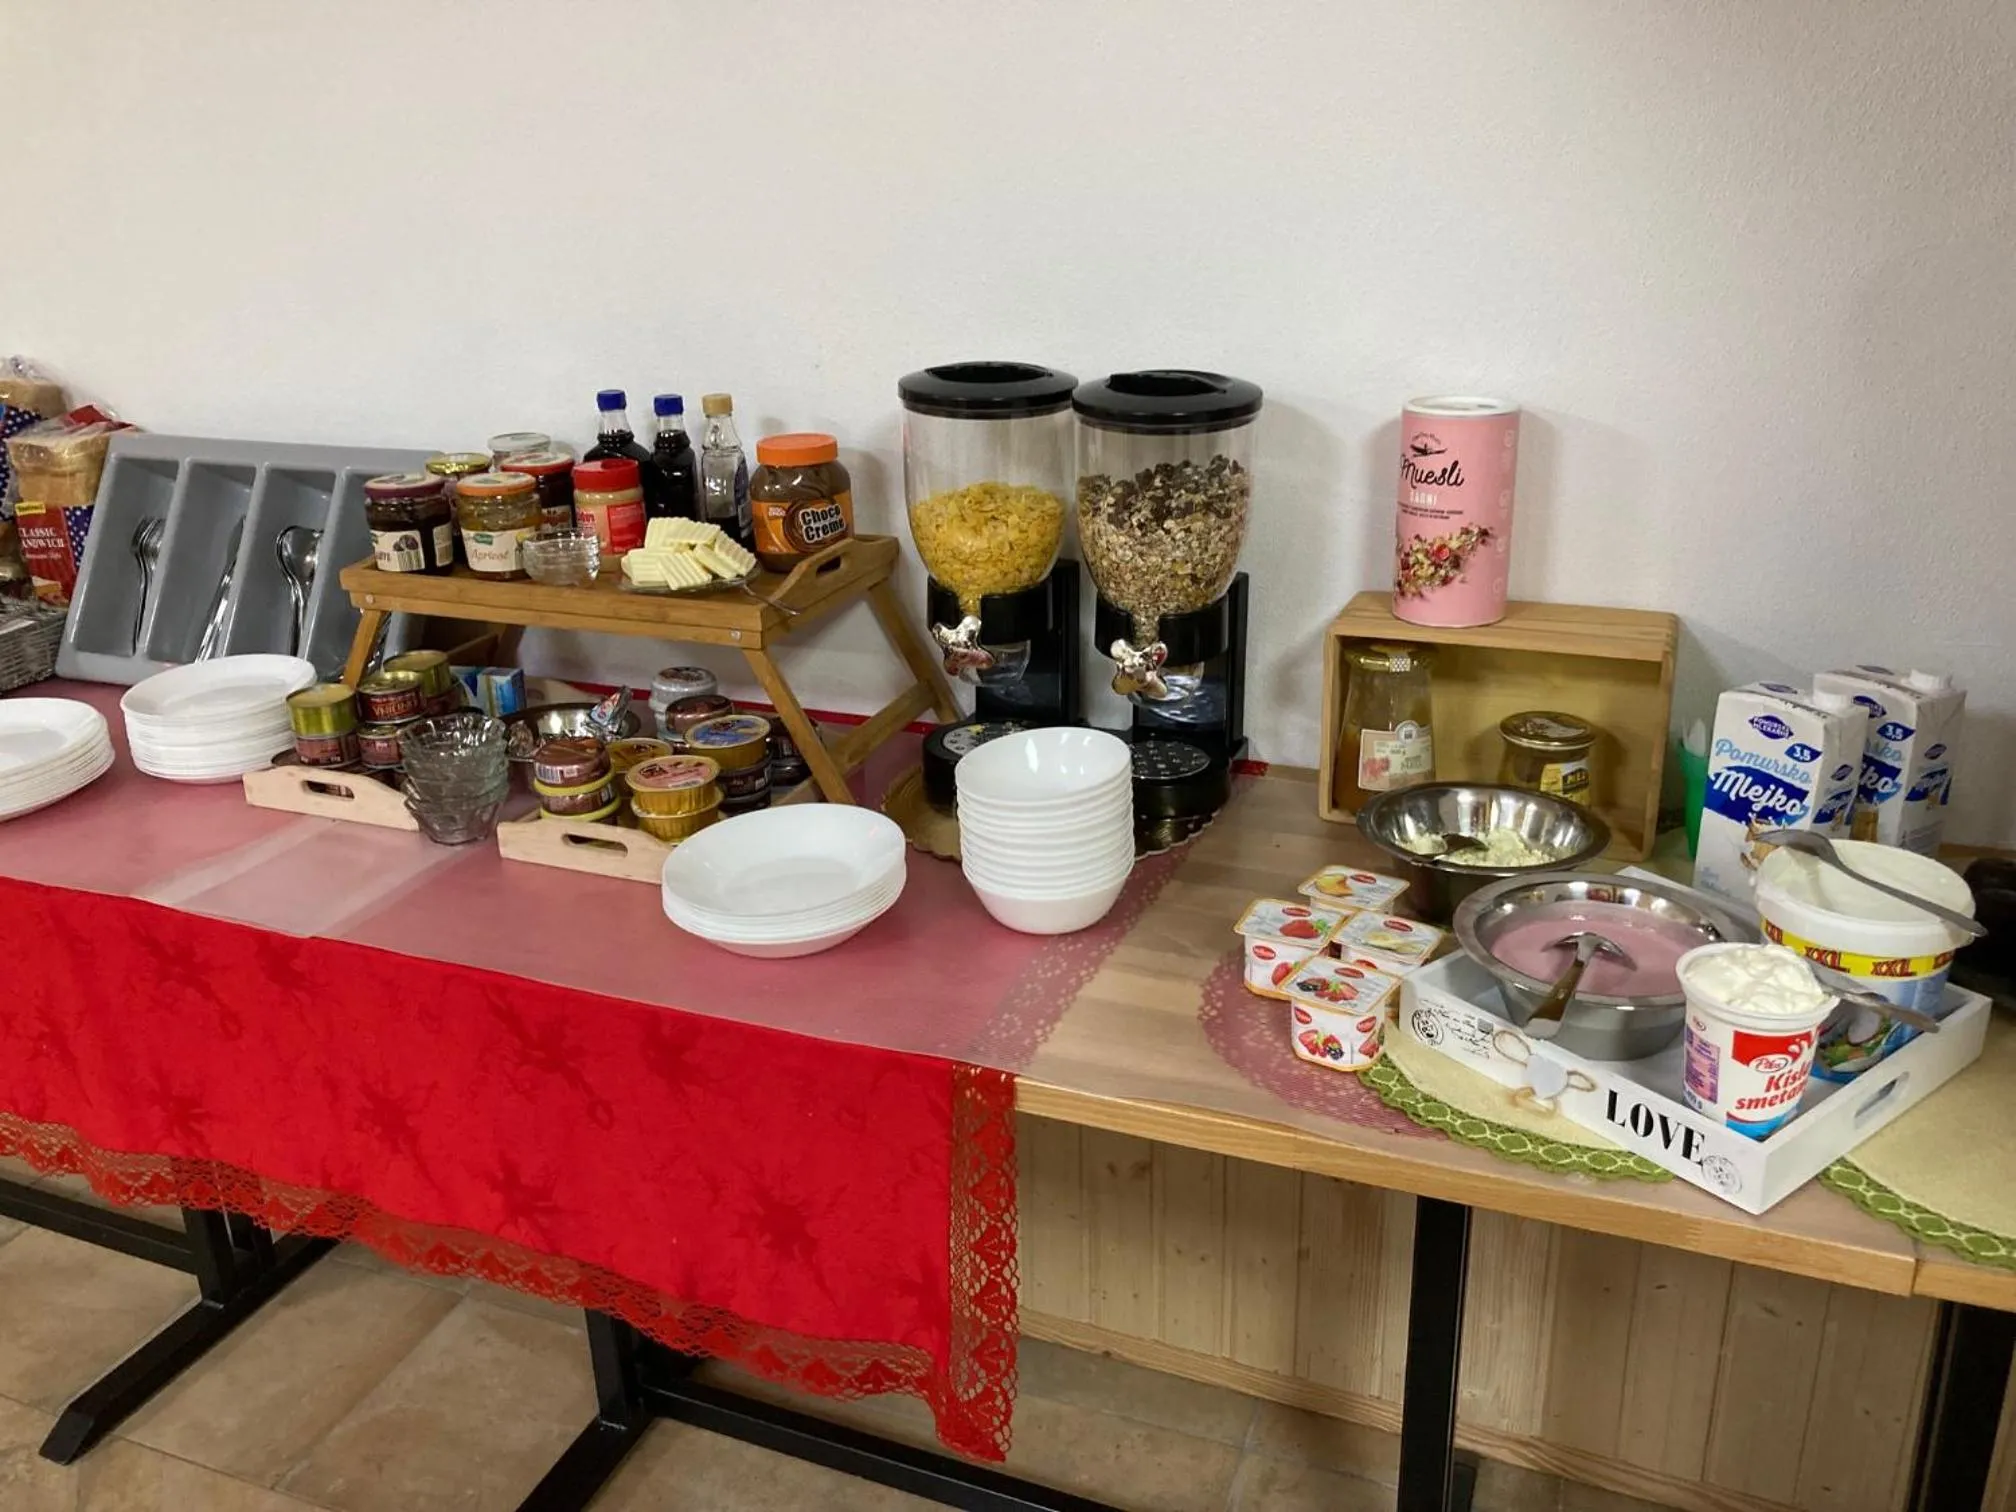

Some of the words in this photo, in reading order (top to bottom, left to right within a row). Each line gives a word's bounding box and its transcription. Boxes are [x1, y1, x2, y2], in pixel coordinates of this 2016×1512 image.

[1401, 454, 1465, 489] Muesli
[801, 504, 841, 526] Choco
[804, 518, 846, 541] Creme
[1886, 724, 1904, 740] 3,5
[1715, 738, 1813, 784] Pomursko
[1793, 746, 1812, 761] 3,5
[1710, 768, 1806, 815] Mlejko
[1804, 946, 1850, 973] XXL
[1870, 958, 1917, 977] XXL
[1606, 1090, 1704, 1168] LOVE
